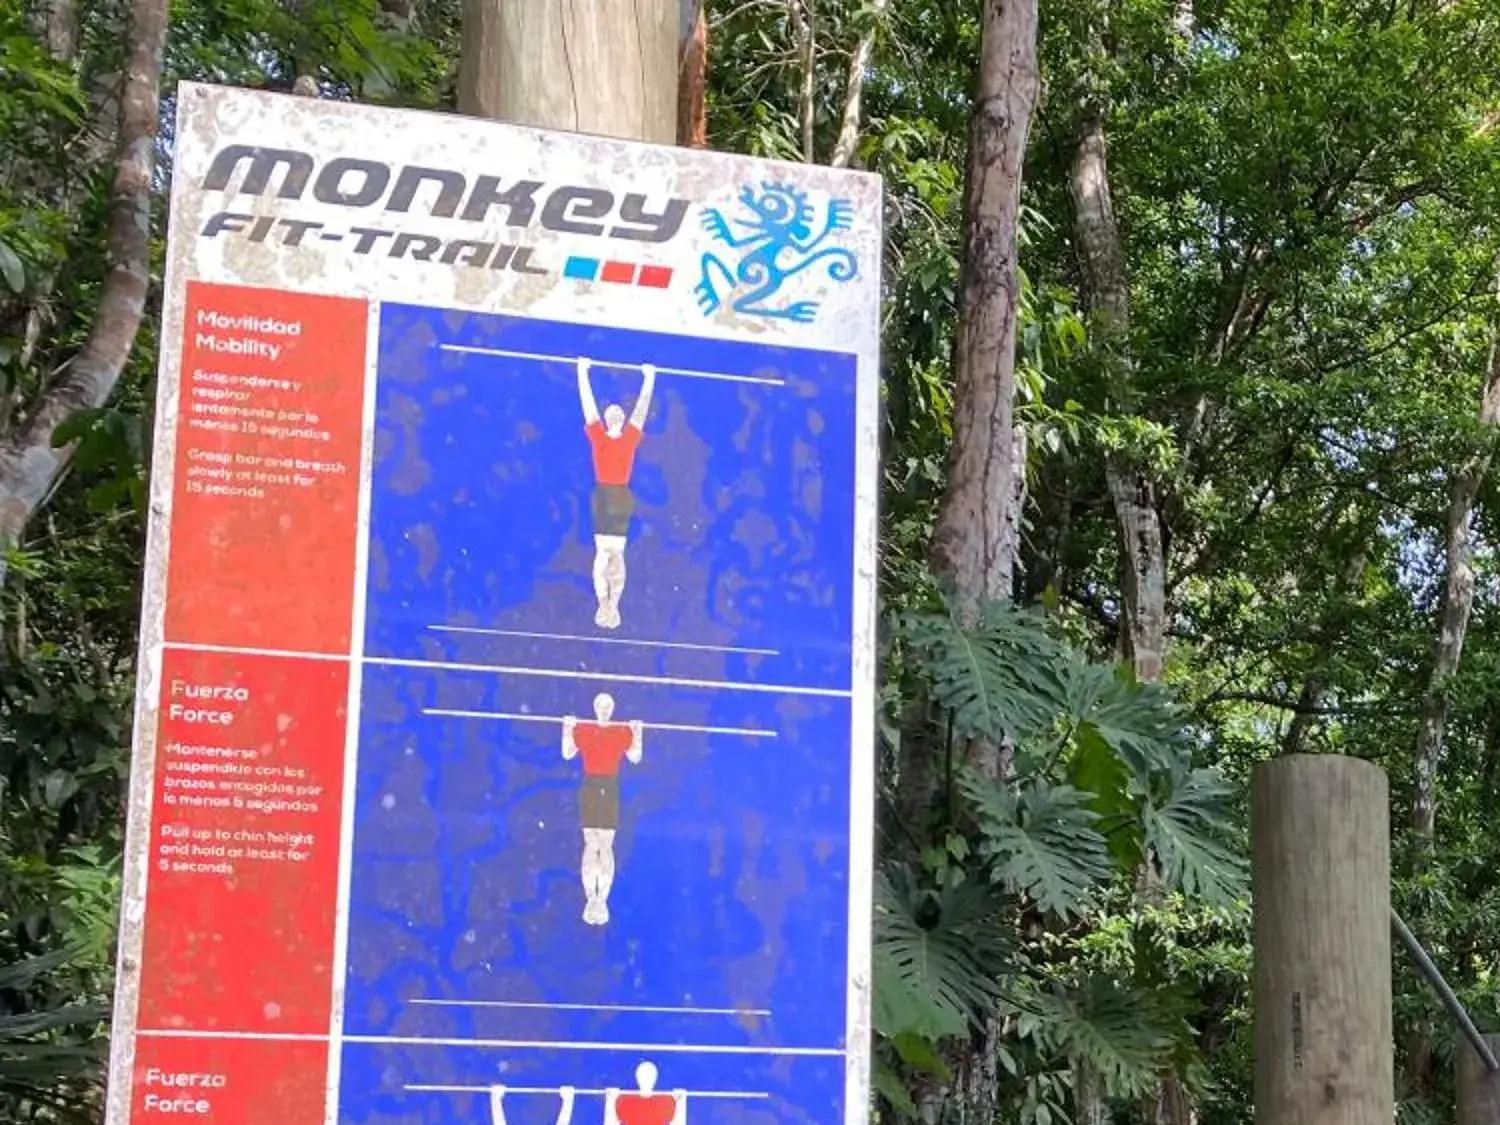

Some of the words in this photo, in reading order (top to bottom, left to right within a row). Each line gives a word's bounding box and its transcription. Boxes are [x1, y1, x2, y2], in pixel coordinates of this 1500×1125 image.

[201, 213, 549, 276] FIT-TRAIL
[197, 310, 301, 335] Movilidad
[195, 333, 281, 360] Mobility
[187, 448, 232, 464] Grasp
[236, 452, 261, 464] bar
[264, 456, 293, 468] and
[187, 466, 232, 481] slowly
[236, 470, 252, 481] at
[254, 472, 290, 484] least
[294, 475, 316, 486] for
[186, 480, 203, 492] 15
[205, 482, 264, 498] seconds
[171, 680, 248, 700] Fuerza
[169, 704, 233, 725] Force
[166, 744, 258, 759] Mantenerse
[255, 766, 281, 777] con
[284, 766, 304, 778] los
[165, 777, 215, 789] brazos
[296, 784, 322, 797] por
[179, 796, 231, 807] menos
[233, 796, 243, 808] 5
[247, 799, 318, 814] segundos
[161, 825, 189, 837] Pull
[193, 828, 211, 840] up
[215, 828, 231, 839] to
[234, 829, 264, 842] chin
[267, 831, 314, 847] height
[160, 844, 188, 856] and
[192, 846, 224, 858] hold
[227, 848, 243, 858] at
[247, 849, 285, 861] least
[288, 850, 309, 861] for
[160, 859, 168, 871] 5
[173, 860, 233, 874] seconds
[146, 1068, 226, 1087] Fuerza
[144, 1094, 209, 1113] Force
